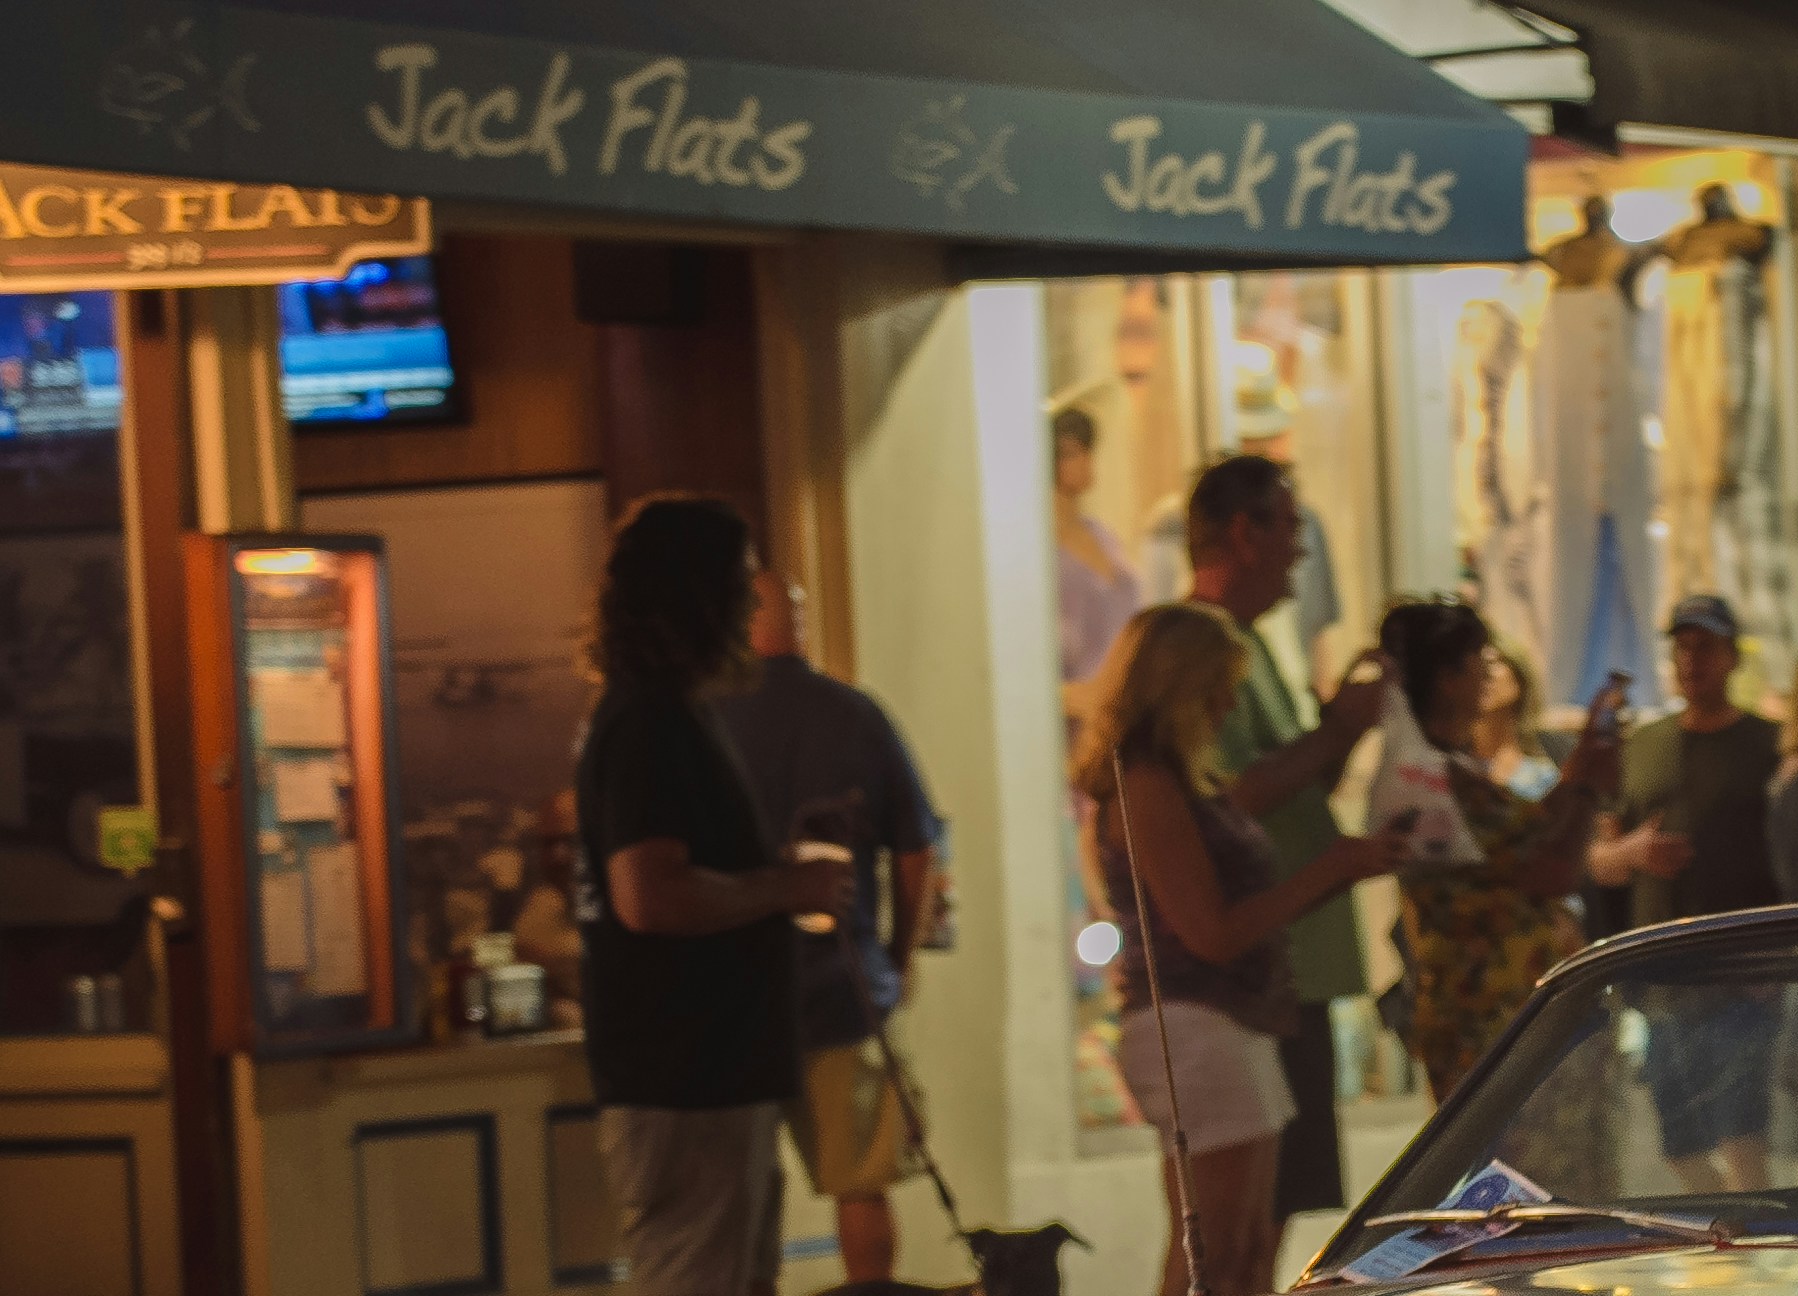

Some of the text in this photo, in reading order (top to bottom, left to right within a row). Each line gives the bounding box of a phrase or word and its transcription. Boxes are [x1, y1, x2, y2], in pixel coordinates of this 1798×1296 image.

[365, 42, 813, 190] Jack Flats
[1102, 115, 1458, 235] Jack Flats
